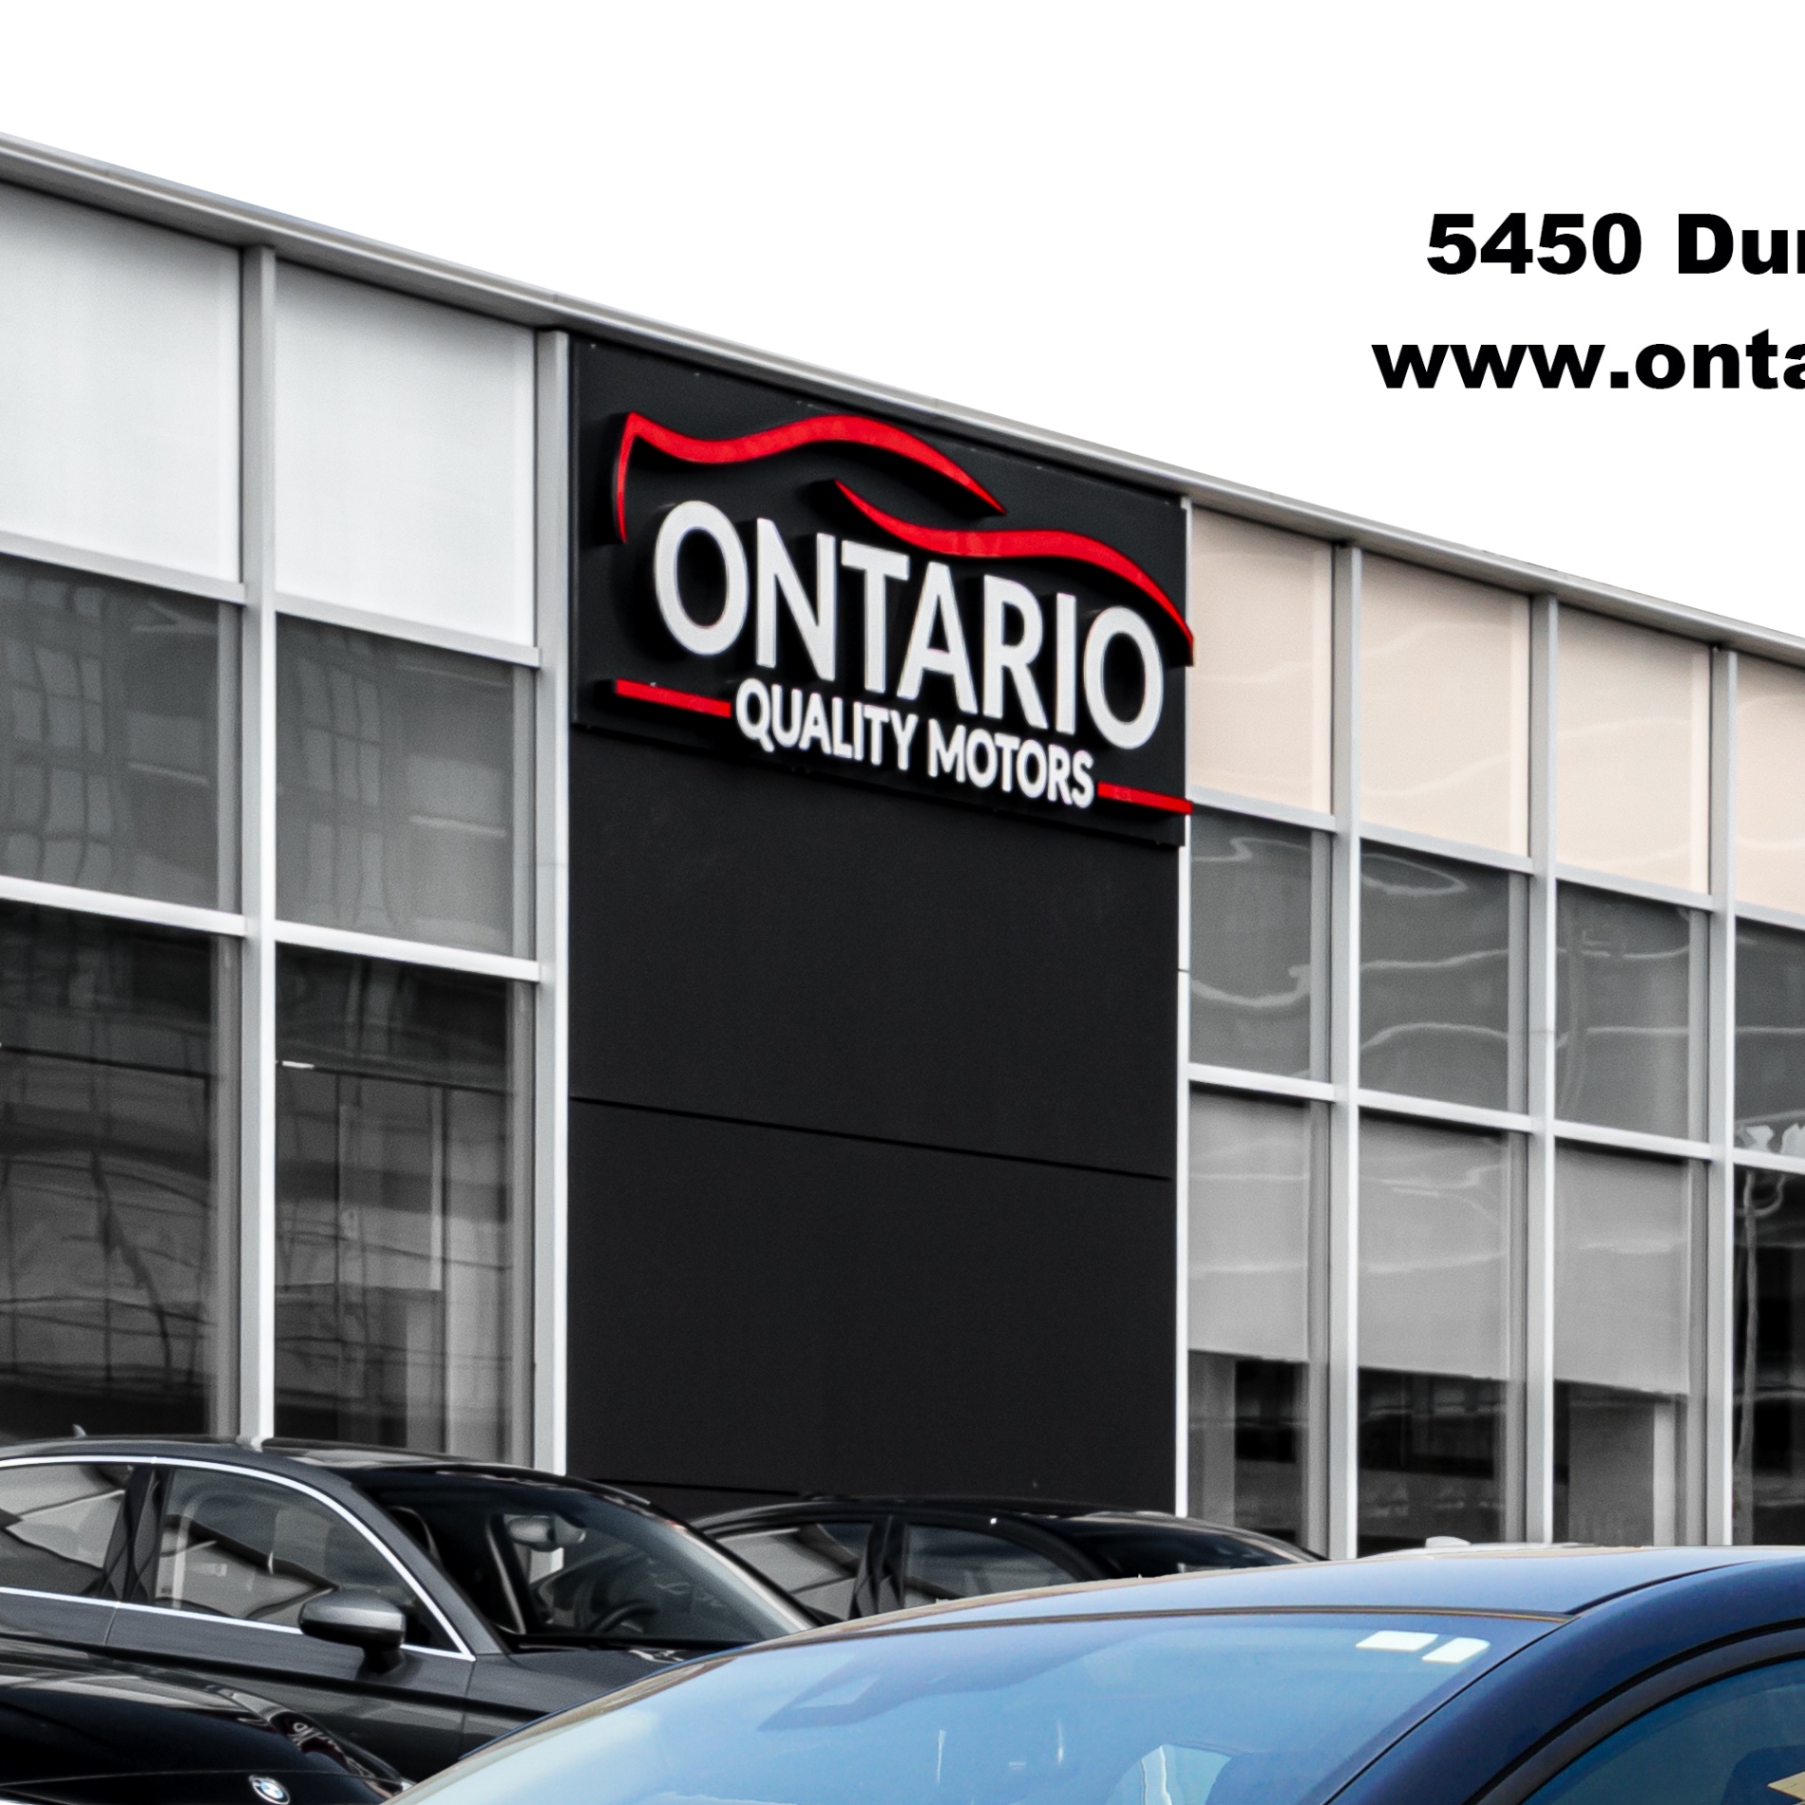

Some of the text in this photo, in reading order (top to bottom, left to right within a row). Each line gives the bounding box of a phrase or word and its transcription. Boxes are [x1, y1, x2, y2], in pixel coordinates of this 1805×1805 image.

[653, 499, 1164, 750] ONTARIO
[735, 678, 1095, 809] QUALITY MOTORS
